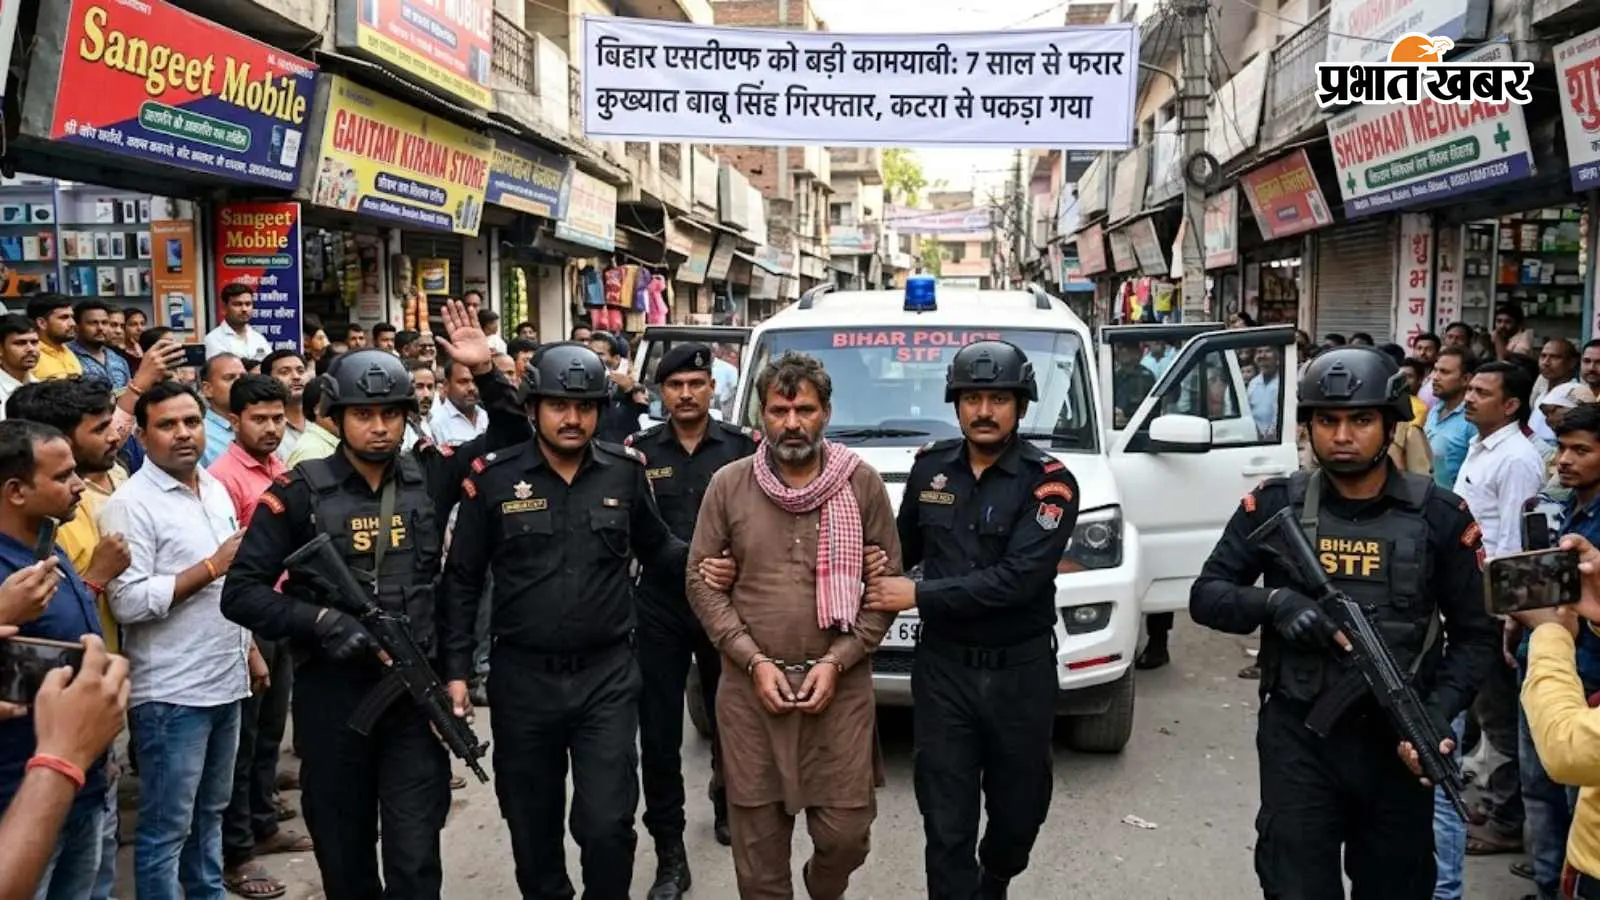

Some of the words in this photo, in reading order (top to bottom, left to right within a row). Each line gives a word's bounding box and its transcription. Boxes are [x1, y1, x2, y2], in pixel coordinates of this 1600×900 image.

[80, 6, 215, 96] Sangeet
[219, 56, 307, 125] Mobile
[595, 36, 657, 69] बिहार
[663, 39, 762, 71] एसटीएफ
[767, 41, 798, 72] को
[805, 42, 846, 79] बड़ी
[852, 43, 958, 75] कामयाबी:
[966, 52, 980, 75] 7
[986, 52, 1036, 75] साल
[1041, 44, 1062, 75] से
[1068, 52, 1125, 75] फरार
[596, 87, 679, 120] कुख्यात
[685, 91, 732, 123] बाबू
[735, 80, 779, 116] सिंह
[785, 84, 883, 121] गिरफ्तार,
[890, 94, 948, 118] कटरा
[954, 87, 975, 118] से
[981, 96, 1044, 125] पकड़ा
[1049, 96, 1094, 119] गया
[333, 108, 399, 164] GAUTAM
[400, 131, 449, 179] KIRANA
[450, 150, 489, 191] STORE
[1334, 109, 1409, 169] SHUBHAM
[221, 208, 292, 229] Sangeet
[226, 231, 288, 249] Mobile
[832, 331, 906, 347] BIHAR
[895, 347, 941, 363] STF
[352, 514, 403, 531] BIHR
[1320, 538, 1379, 554] BIHAR
[1319, 552, 1380, 576] STF
